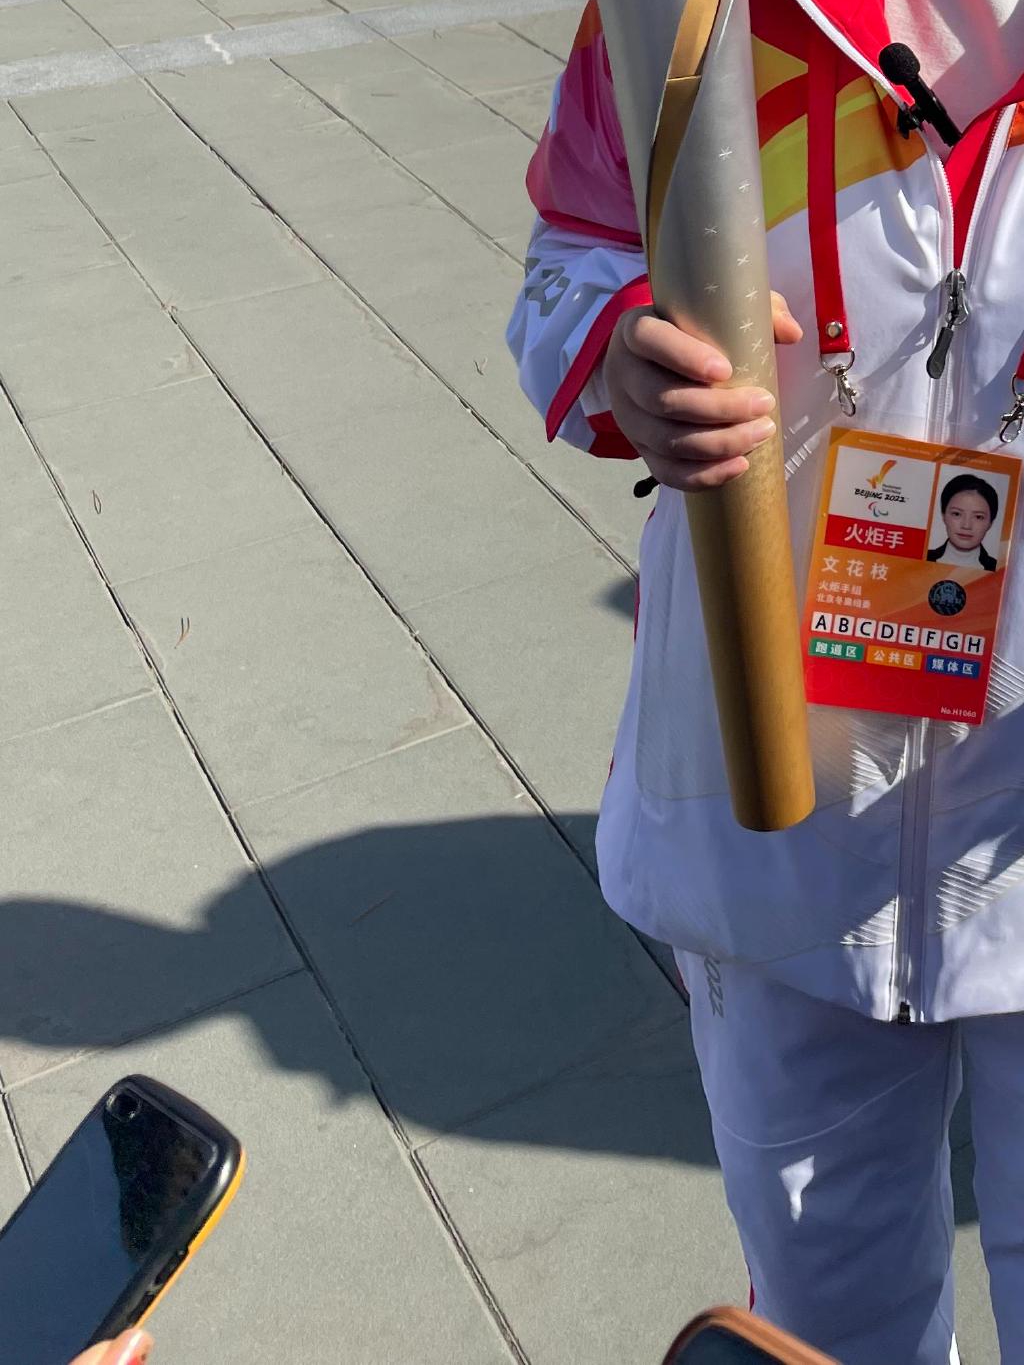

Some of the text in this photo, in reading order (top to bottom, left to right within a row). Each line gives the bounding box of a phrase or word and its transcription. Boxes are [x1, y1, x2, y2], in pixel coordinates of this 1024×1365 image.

[854, 488, 883, 499] BEIJING
[884, 494, 906, 503] 2022
[844, 524, 905, 549] 火炬手
[821, 556, 889, 581] 文花枝
[815, 641, 974, 675] 跑道区 公共区 媒体区
